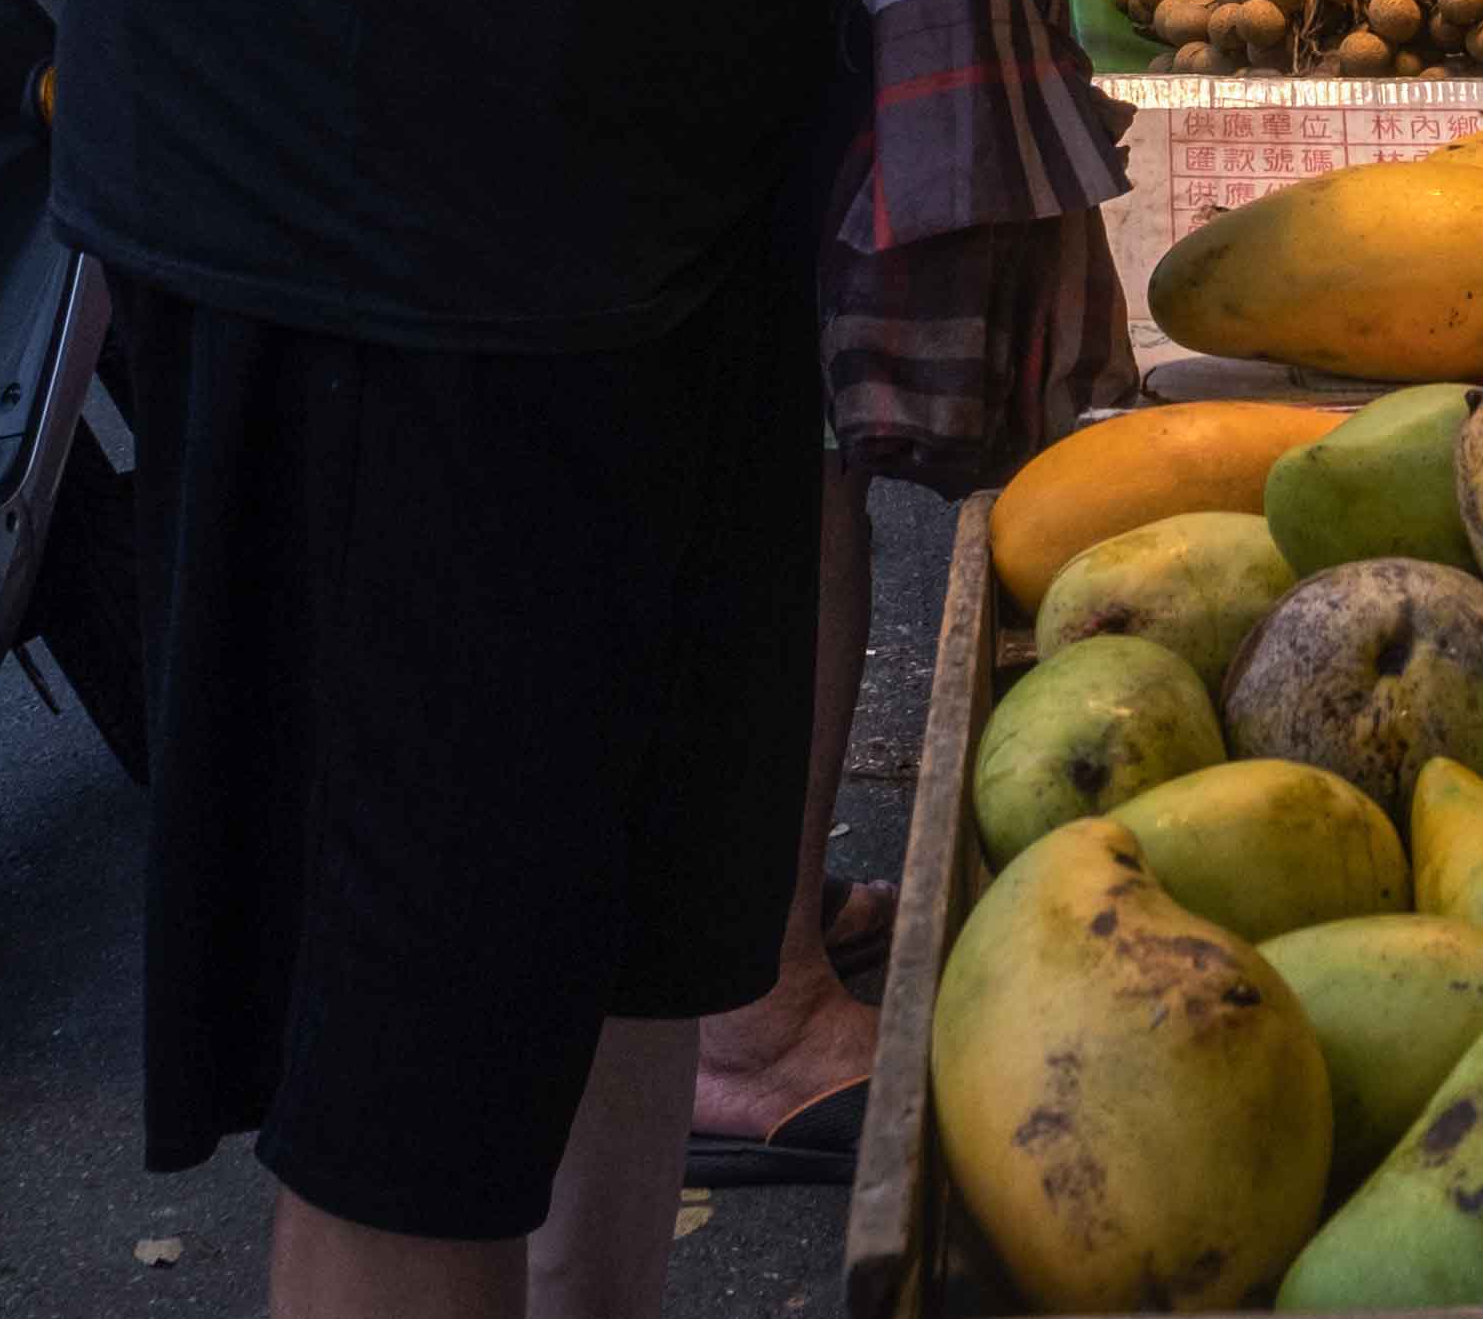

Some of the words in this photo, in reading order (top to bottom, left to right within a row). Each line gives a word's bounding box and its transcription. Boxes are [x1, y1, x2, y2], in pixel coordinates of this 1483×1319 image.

[1181, 113, 1335, 141] 供應單位
[1185, 144, 1335, 174] 匯款號碼
